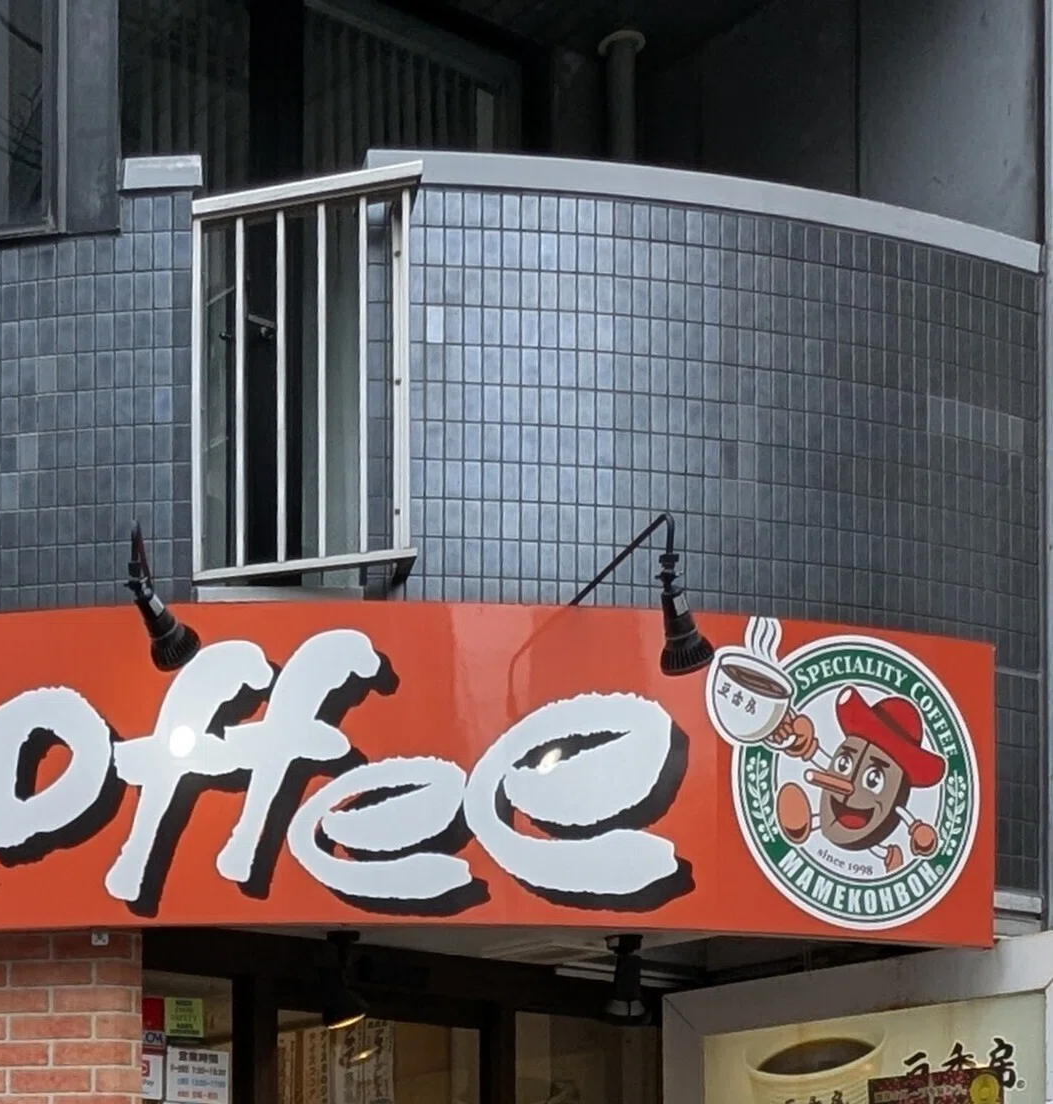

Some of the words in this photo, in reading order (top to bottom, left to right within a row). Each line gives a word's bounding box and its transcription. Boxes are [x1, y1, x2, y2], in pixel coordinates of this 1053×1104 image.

[796, 655, 908, 690] SPECIALITY
[909, 684, 958, 757] COFFEE
[778, 849, 937, 914] MAMEKOHBOH
[817, 850, 846, 868] since
[847, 862, 874, 877] 1998
